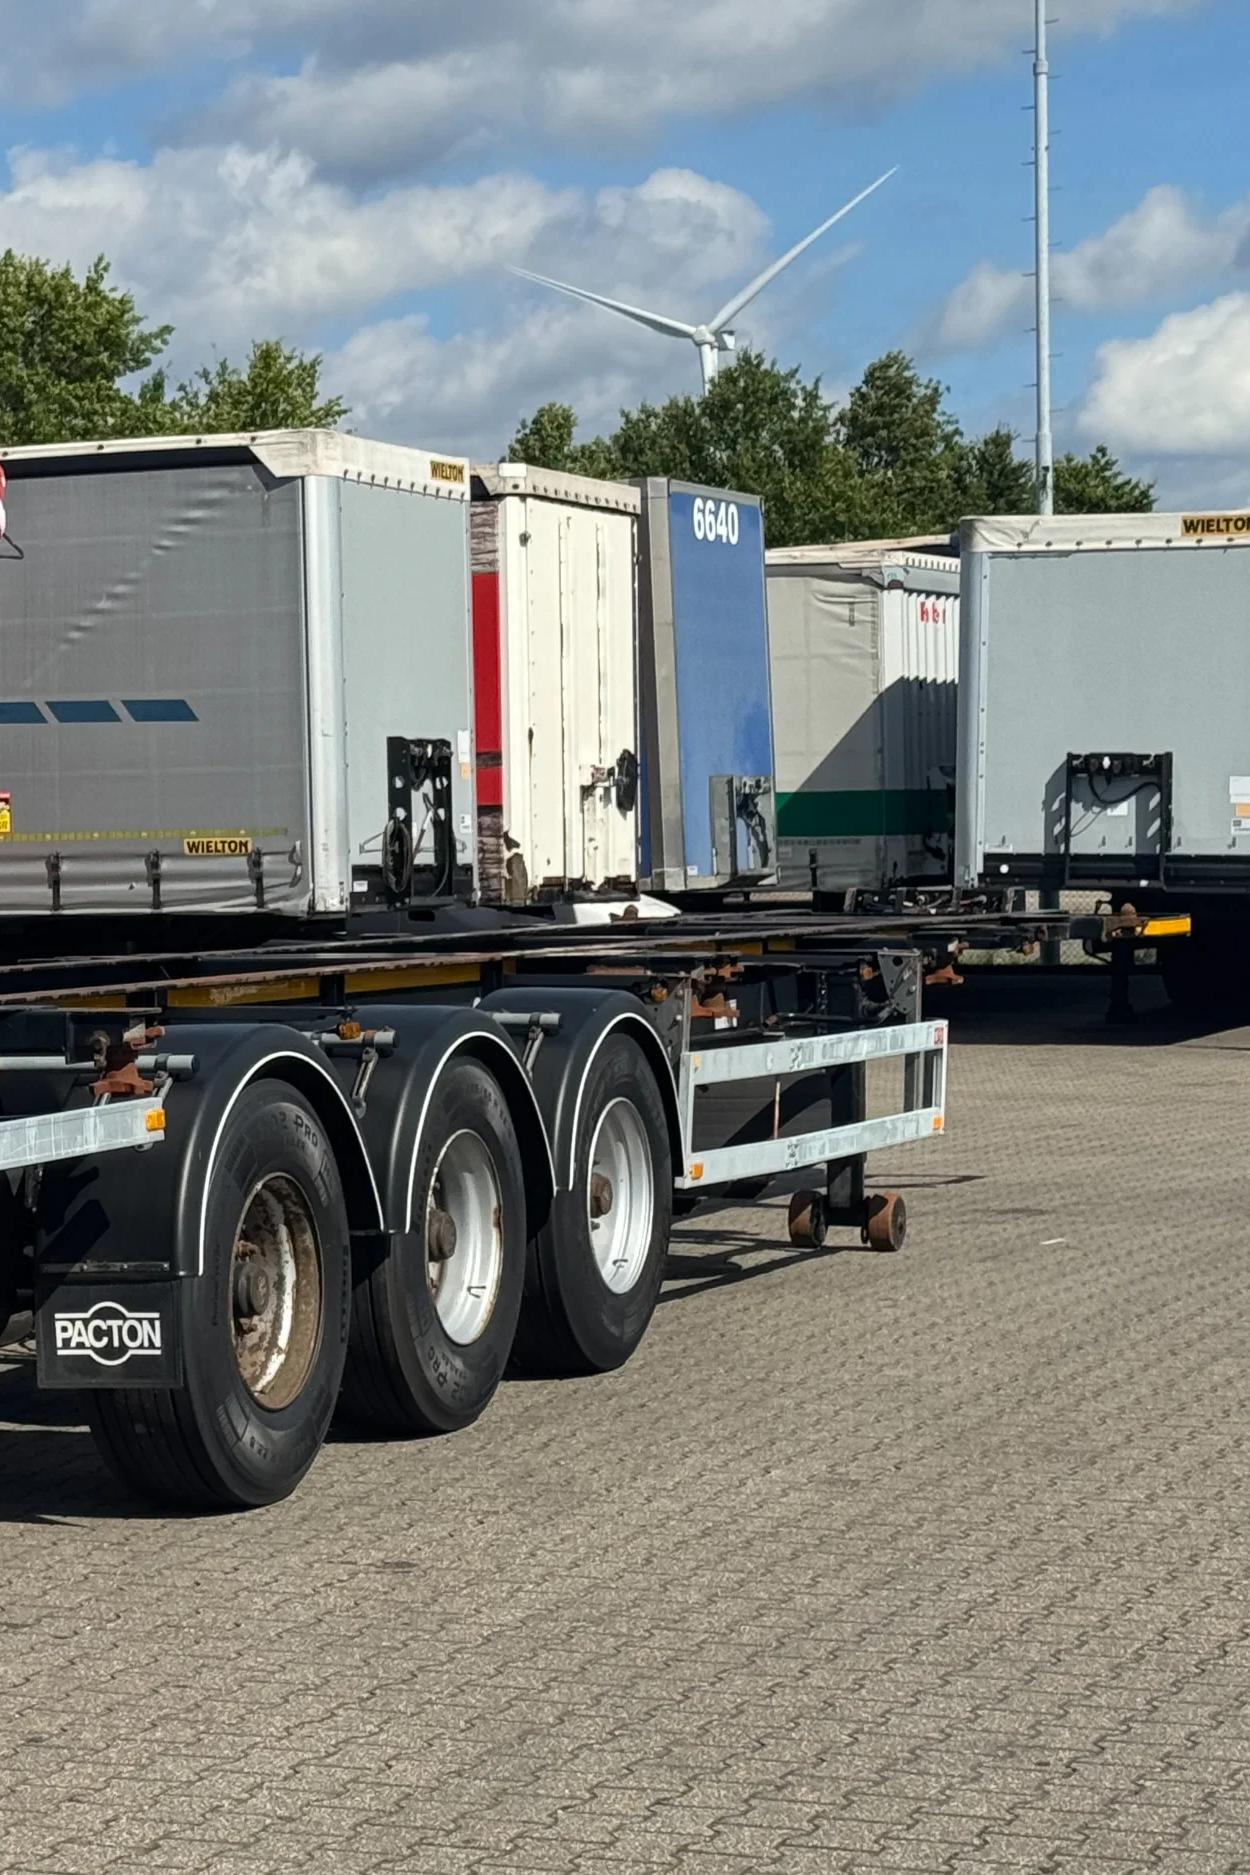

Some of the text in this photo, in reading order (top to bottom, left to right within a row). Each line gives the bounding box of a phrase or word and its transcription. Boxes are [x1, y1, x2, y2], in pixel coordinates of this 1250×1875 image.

[430, 460, 464, 483] WIELTON
[693, 497, 739, 545] 6640
[186, 840, 249, 854] WIELTON
[54, 1319, 162, 1348] PACTON
